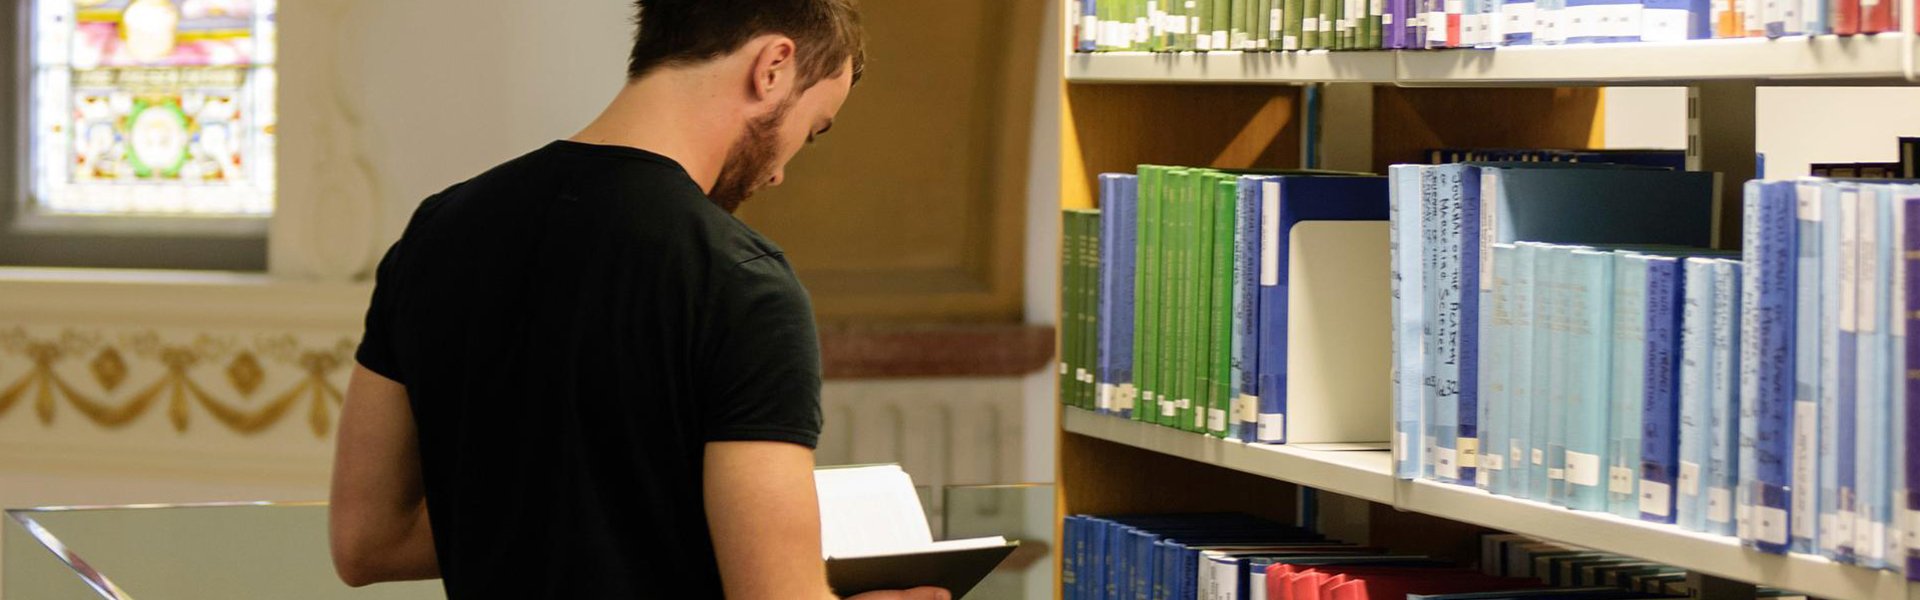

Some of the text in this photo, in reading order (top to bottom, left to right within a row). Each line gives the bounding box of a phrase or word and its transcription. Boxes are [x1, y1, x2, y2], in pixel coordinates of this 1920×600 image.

[1451, 171, 1462, 238] JOURNAL
[1439, 198, 1450, 280] MARKETING
[1437, 288, 1450, 356] SCIENCE
[1445, 302, 1461, 366] ACADEMY
